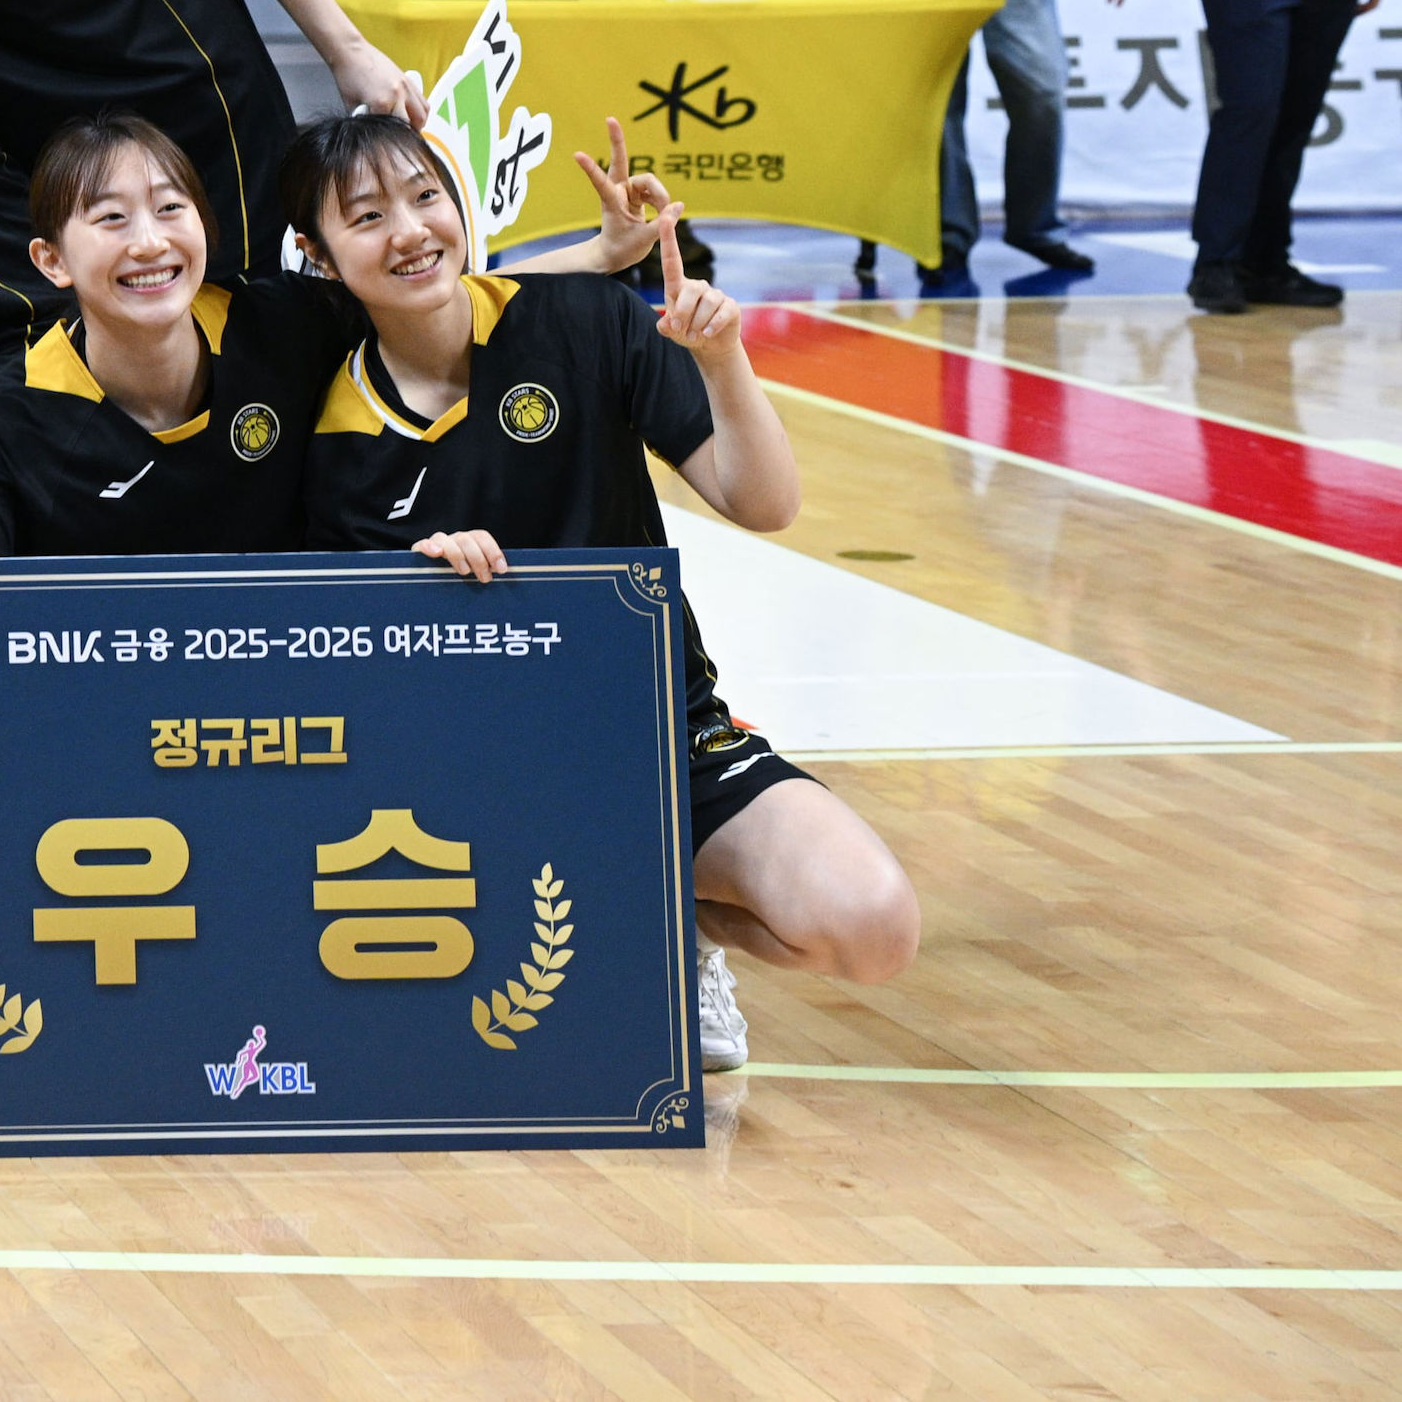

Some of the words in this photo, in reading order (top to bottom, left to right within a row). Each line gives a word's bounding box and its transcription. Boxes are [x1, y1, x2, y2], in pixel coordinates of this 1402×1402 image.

[664, 152, 785, 183] 국민은행
[7, 630, 106, 665] BNK
[110, 626, 175, 663] 금융
[184, 625, 375, 660] 2025-2026
[382, 621, 563, 658] 여자프로농구
[150, 715, 348, 768] 정규리그
